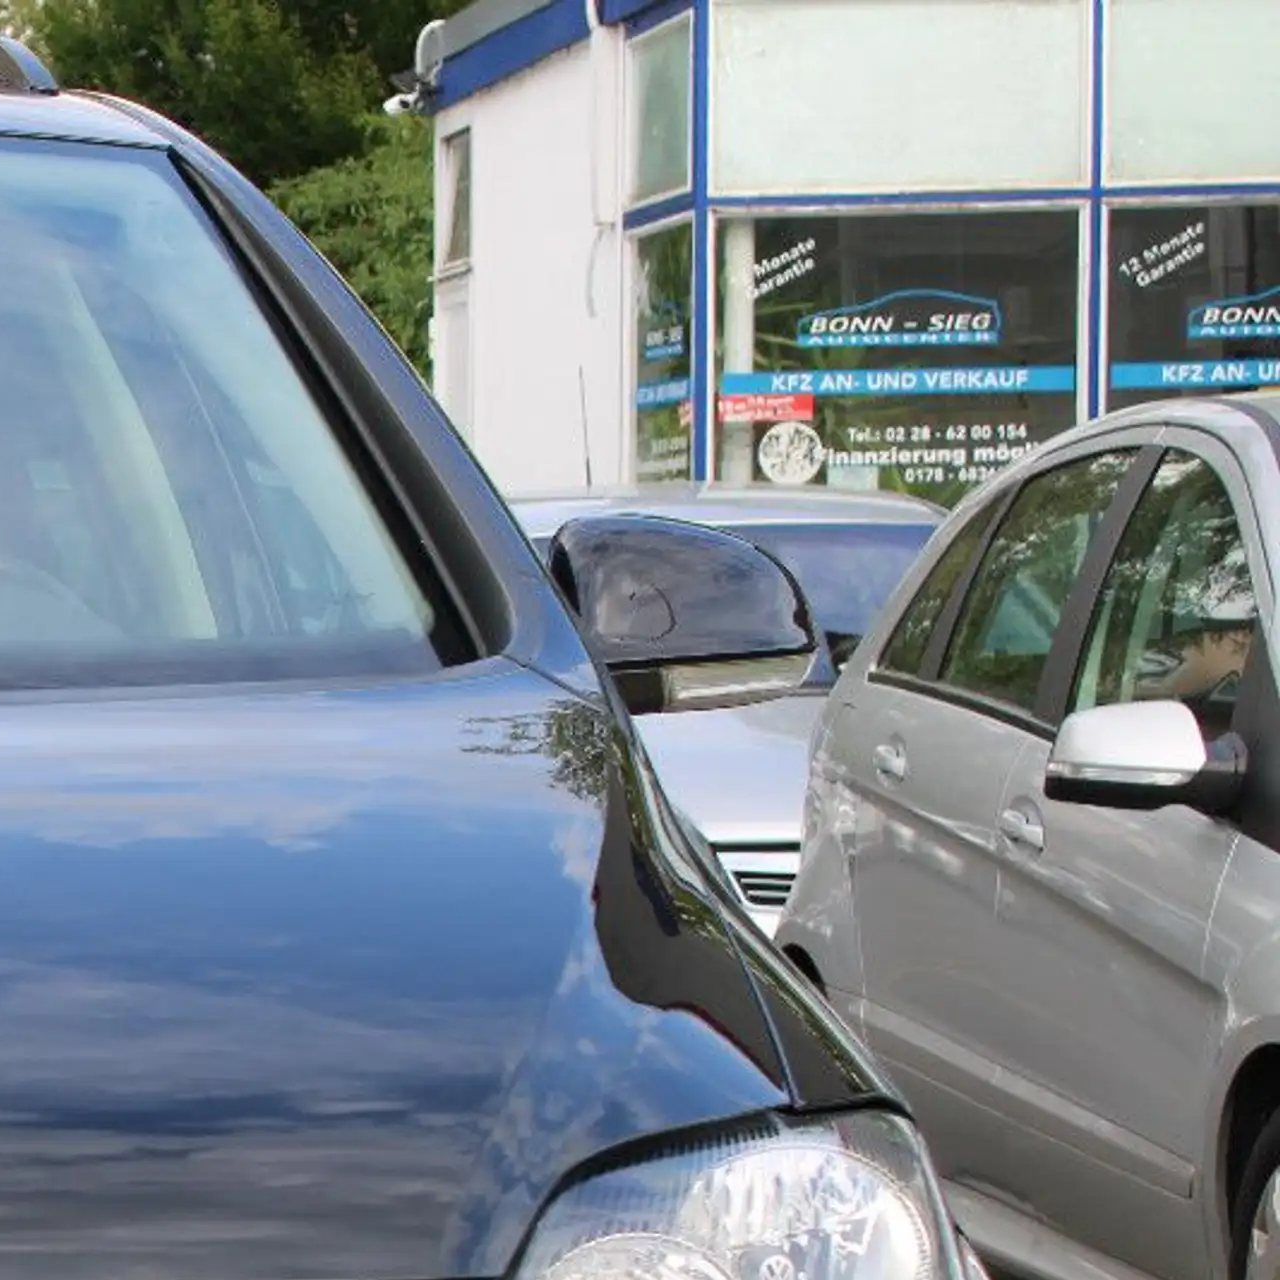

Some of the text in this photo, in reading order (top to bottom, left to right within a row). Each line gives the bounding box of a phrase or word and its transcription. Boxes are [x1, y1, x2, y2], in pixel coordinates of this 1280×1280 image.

[1119, 222, 1205, 277] 12 Monate
[1135, 241, 1206, 287] Garantie
[809, 315, 895, 334] BONN
[928, 313, 992, 332] SIEG
[770, 374, 814, 392] KFZ
[866, 372, 918, 390] UND
[924, 369, 1030, 388] VERKAUF
[1162, 363, 1206, 383] KFZ
